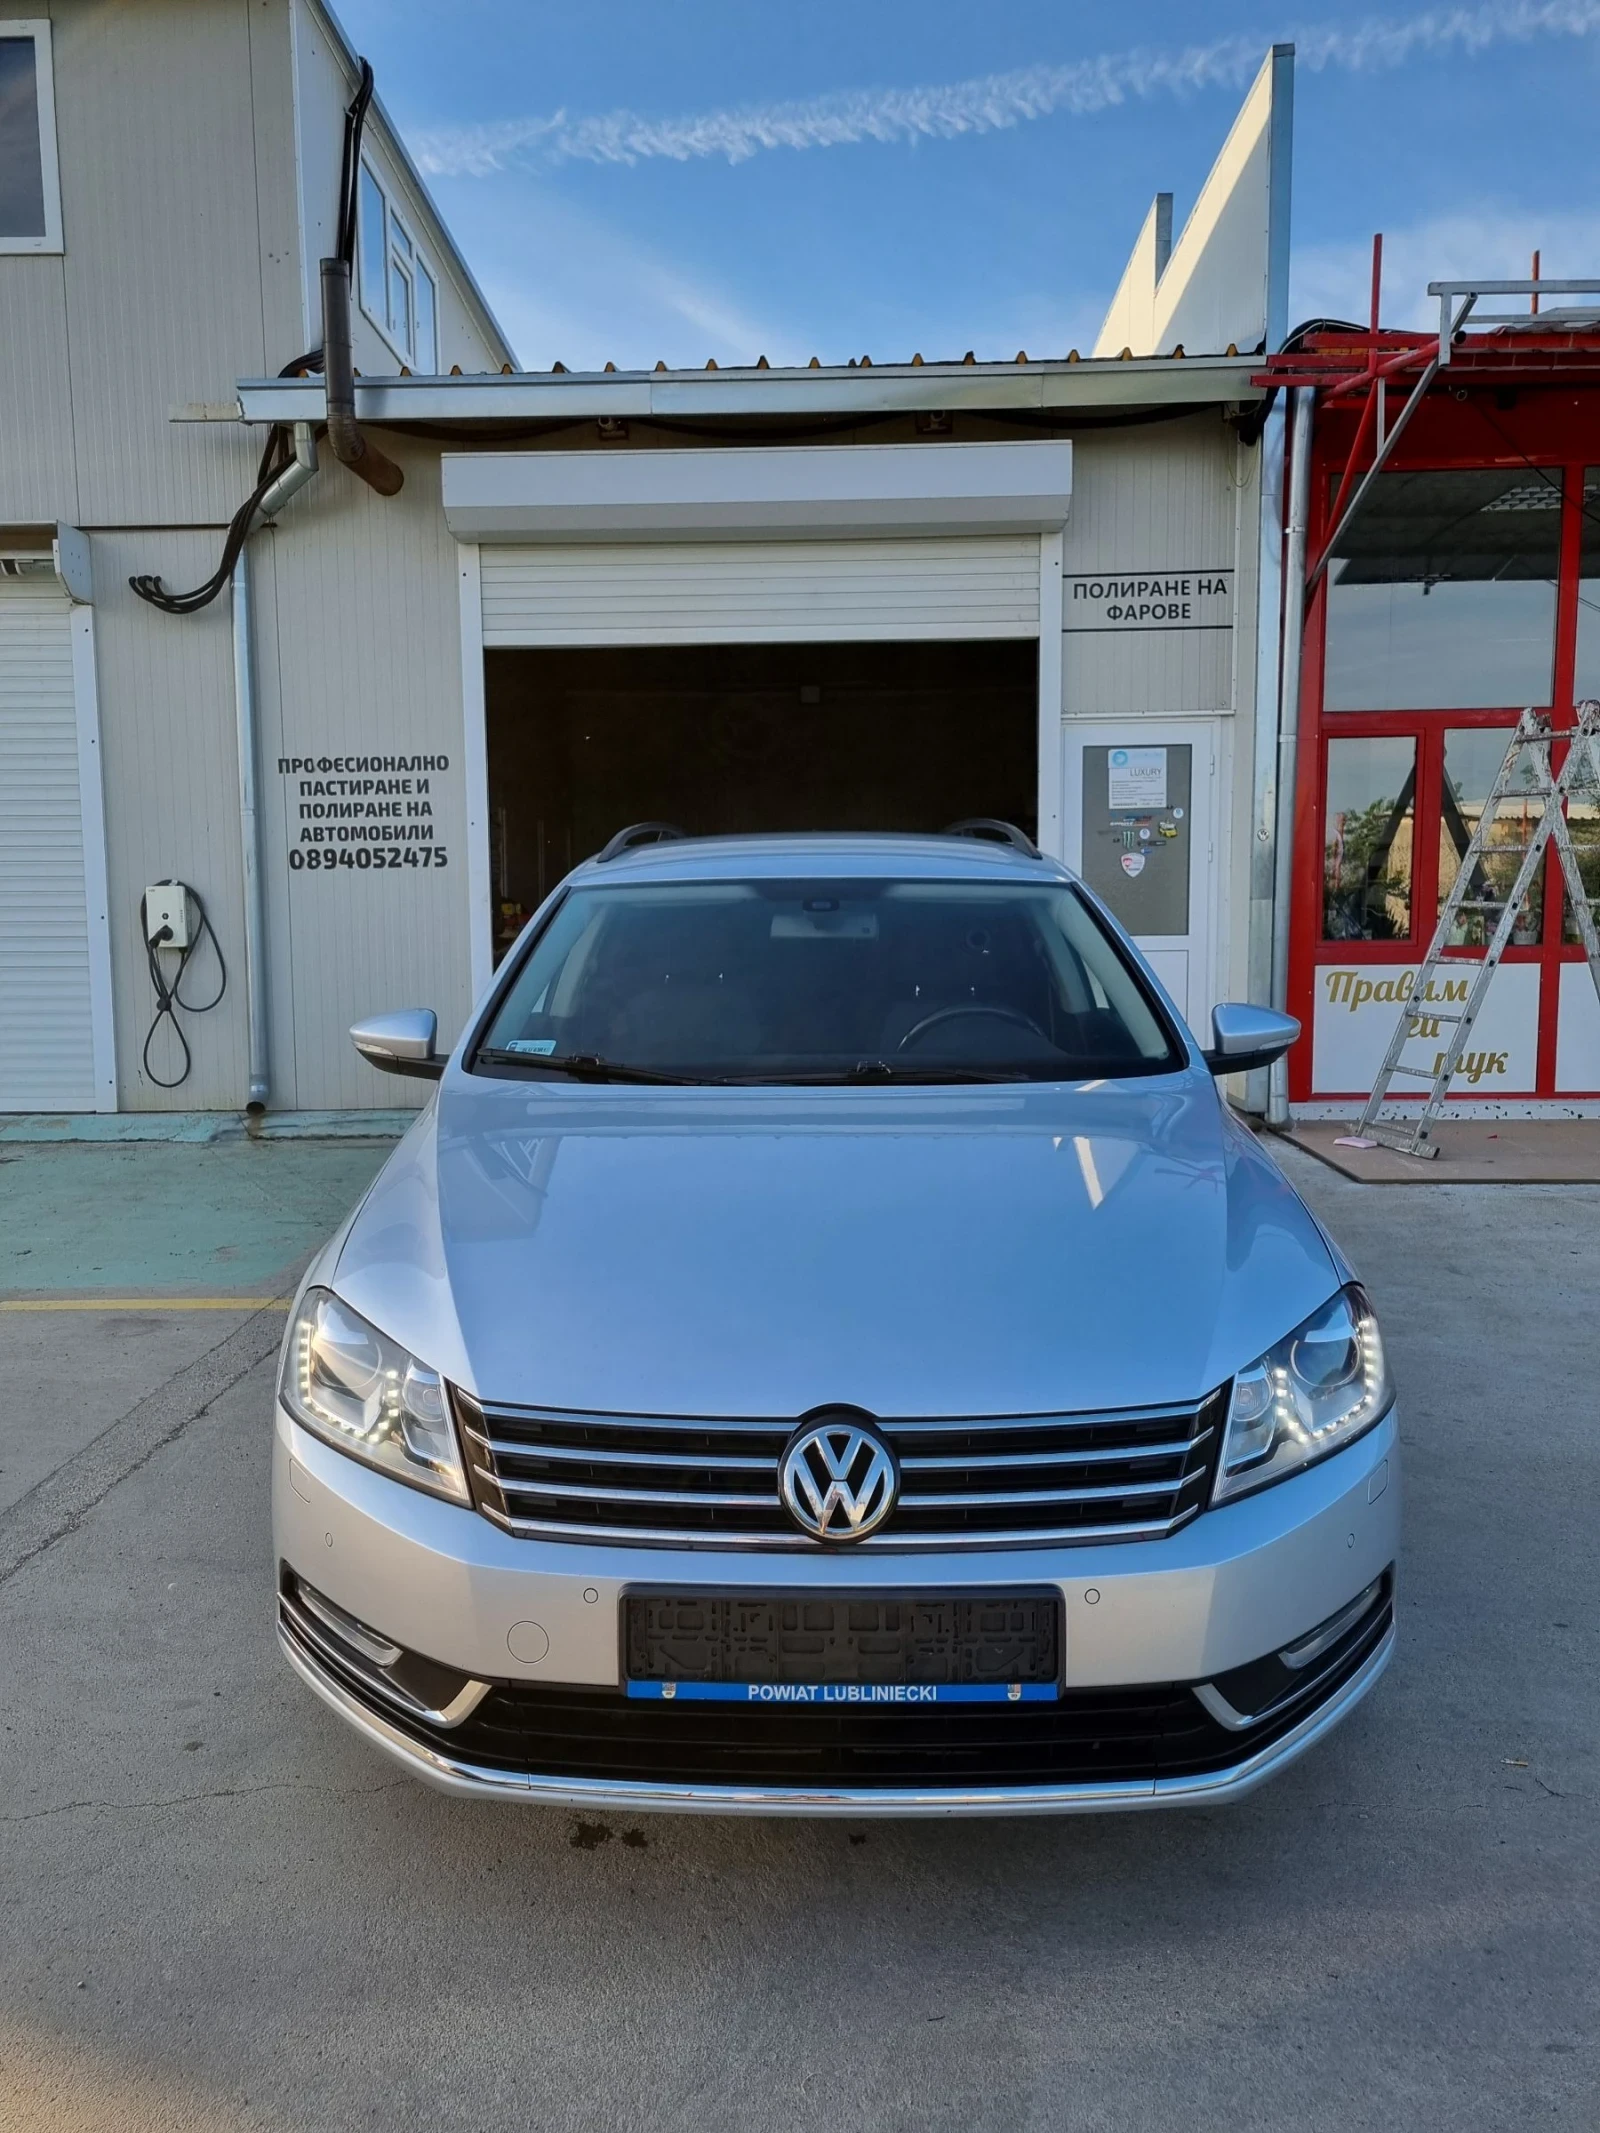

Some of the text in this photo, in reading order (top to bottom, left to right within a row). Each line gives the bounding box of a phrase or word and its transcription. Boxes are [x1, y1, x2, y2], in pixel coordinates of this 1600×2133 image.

[1073, 579, 1228, 599] ПОЛИРАНЕ НА
[1106, 603, 1192, 620] ФАРОВЕ
[278, 755, 450, 774] ПРОФЕСИОНАЛНО
[1130, 768, 1162, 777] LUXURY
[300, 779, 430, 797] ПАСТИРАНЕ И
[299, 801, 433, 819] ПОЛИРАНЕ НА
[300, 825, 434, 843] АВТОМОБИЛИ
[289, 846, 448, 871] 0894052475
[748, 1685, 937, 1701] POWIAT LUBLINIECKI
